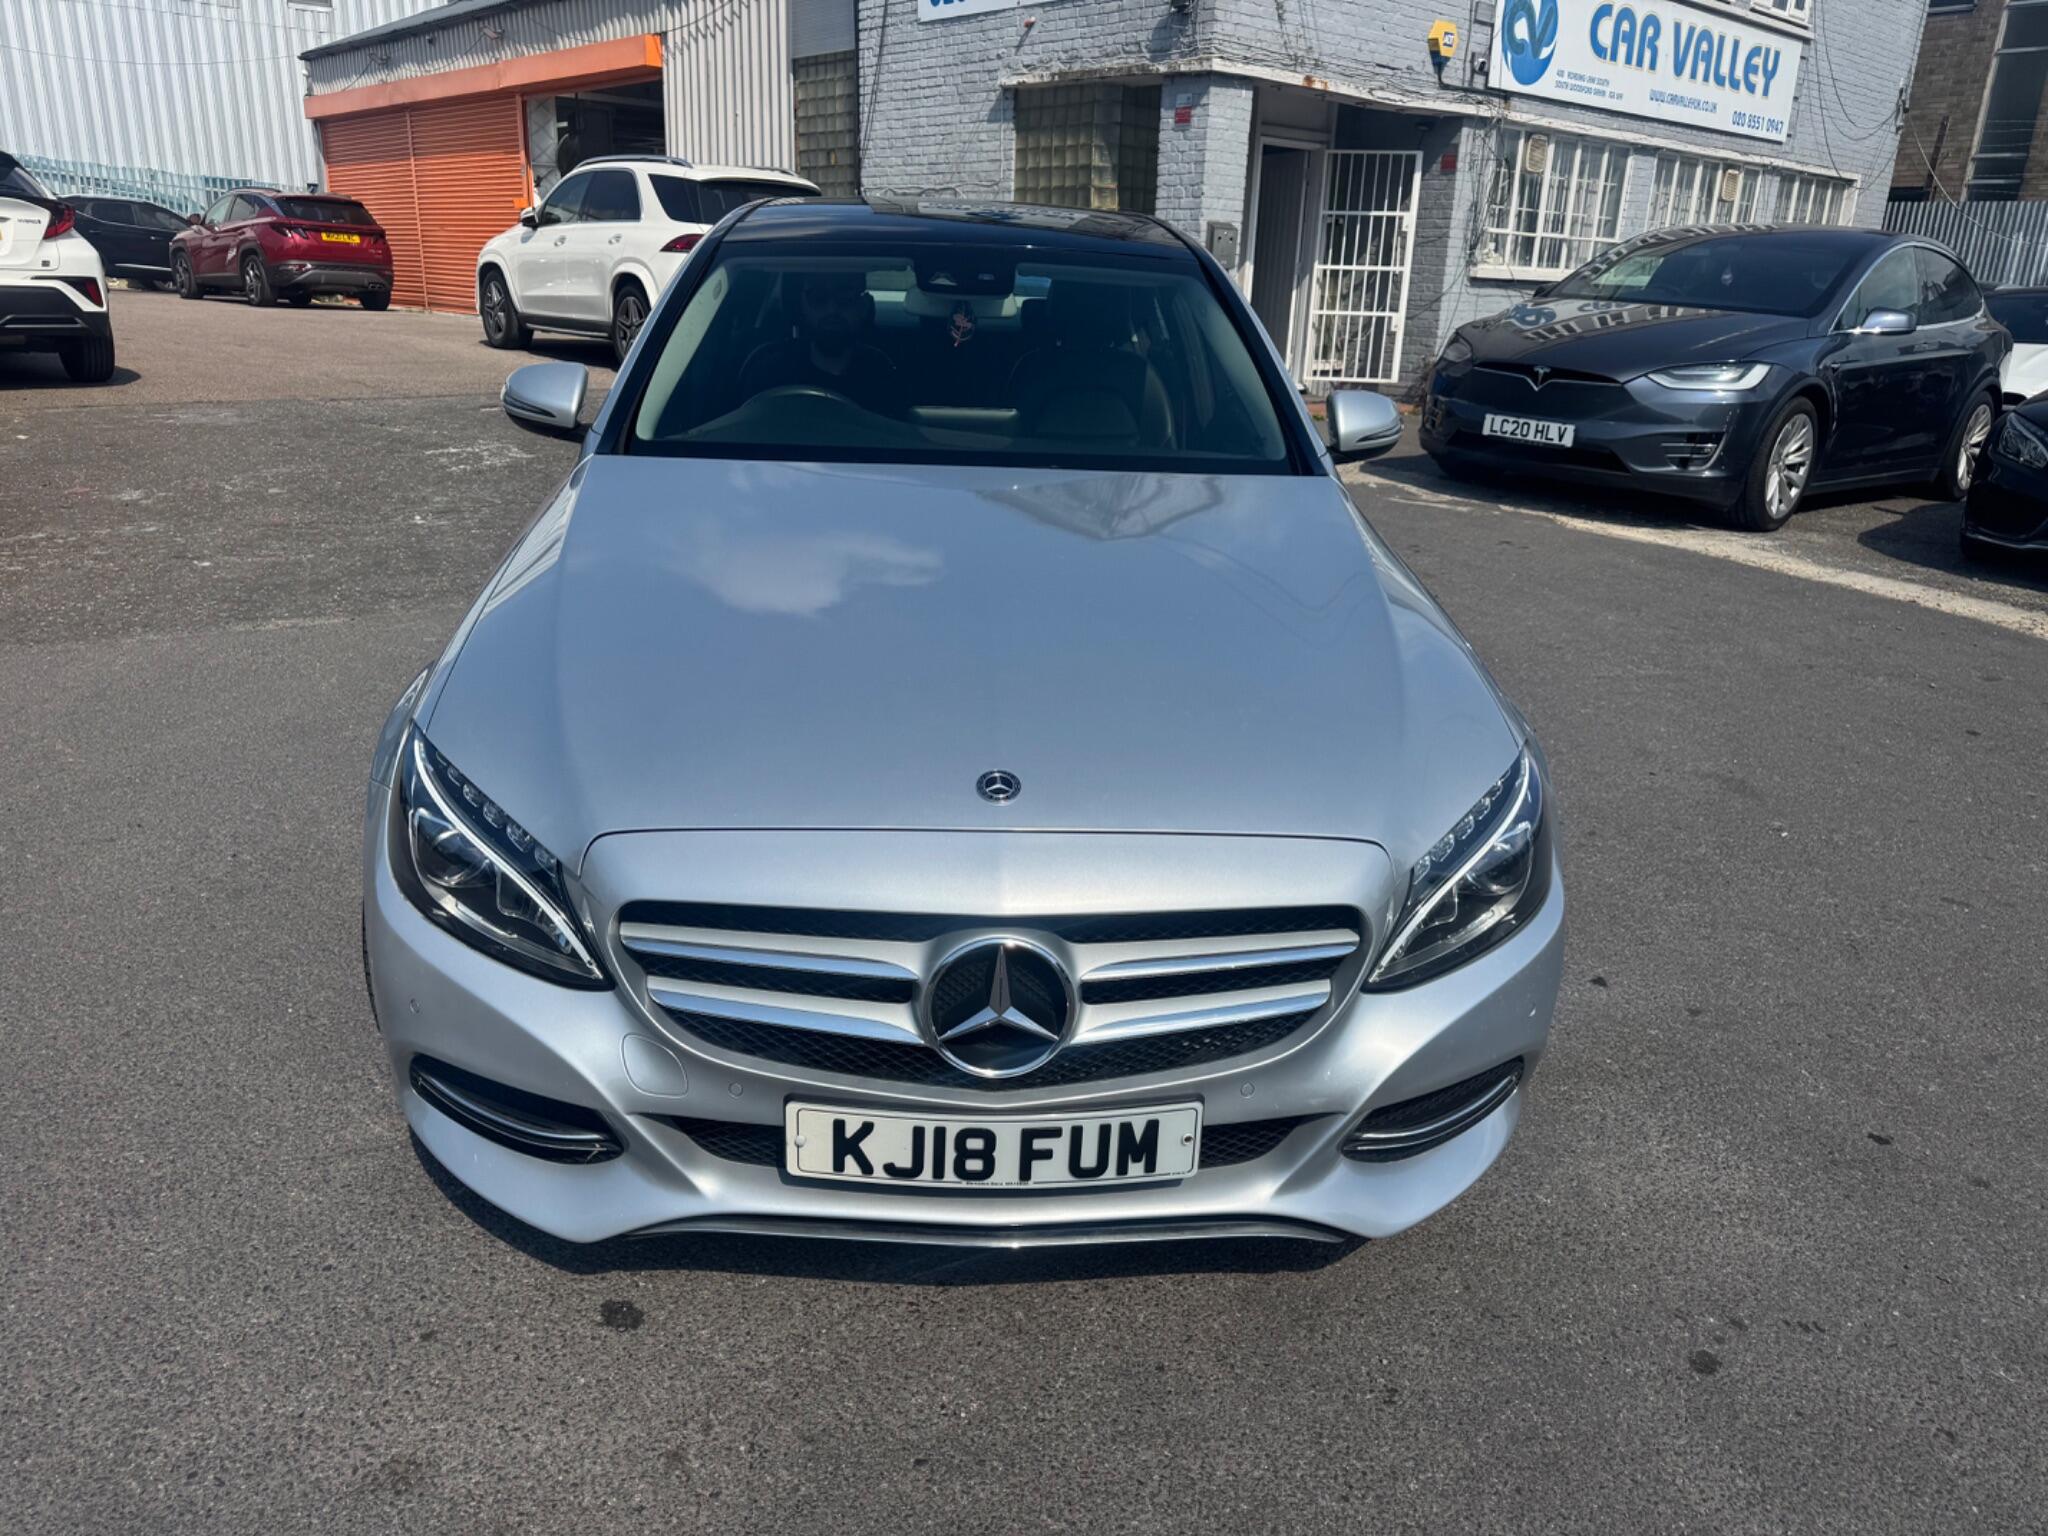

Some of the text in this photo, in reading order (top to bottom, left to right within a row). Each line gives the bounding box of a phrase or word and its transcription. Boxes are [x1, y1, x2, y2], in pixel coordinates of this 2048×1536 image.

[1589, 3, 1781, 97] CAR VALLEY
[1732, 110, 1784, 135] 020 8551 0947
[1489, 416, 1531, 438] LC20
[1533, 421, 1568, 443] HLV
[832, 1118, 1160, 1182] KJ18 FUM
